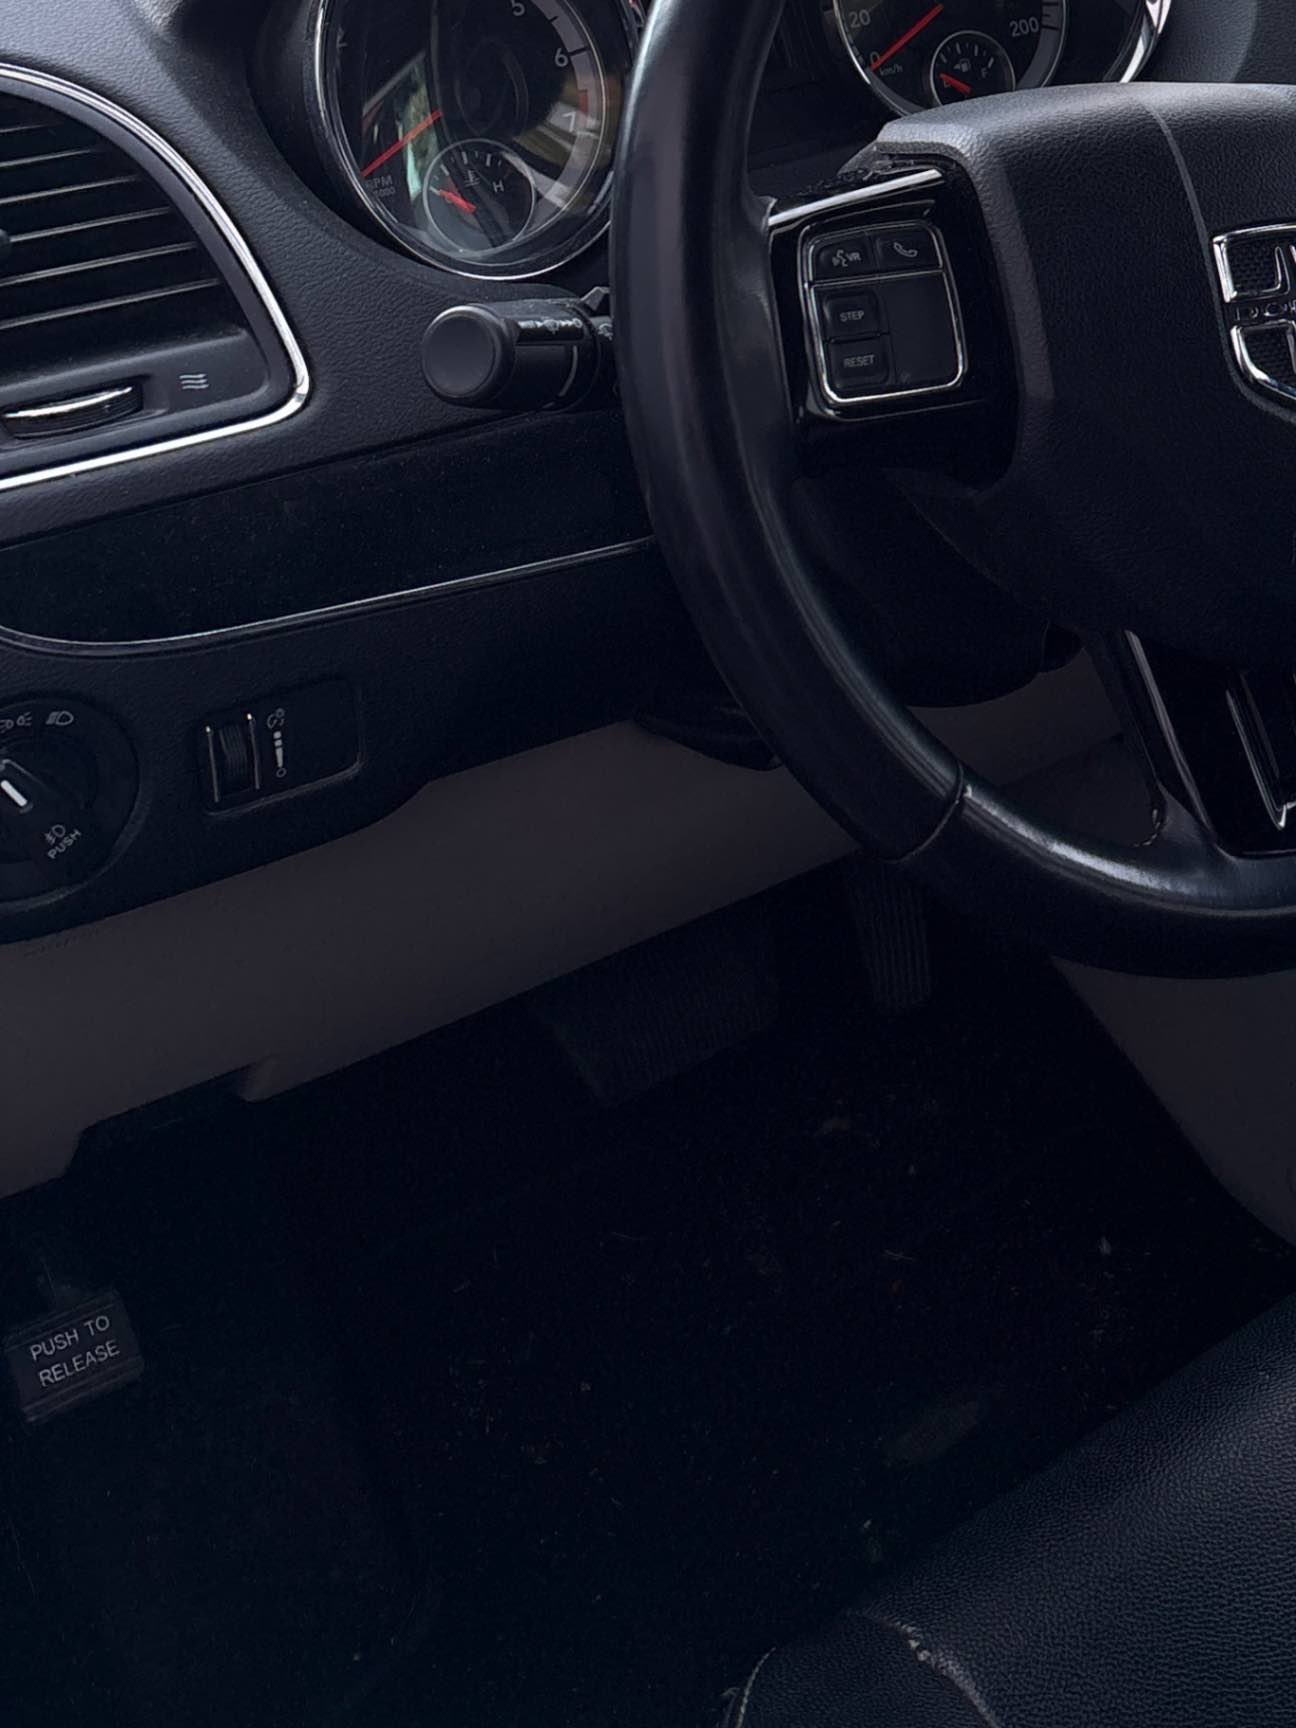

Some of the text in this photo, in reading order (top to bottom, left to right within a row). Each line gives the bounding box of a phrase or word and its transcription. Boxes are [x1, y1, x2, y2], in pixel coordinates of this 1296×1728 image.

[849, 9, 871, 29] 20
[1009, 16, 1040, 38] 200
[553, 47, 569, 68] 6
[561, 111, 577, 133] 7
[839, 309, 865, 322] STEP
[843, 354, 876, 368] RESET
[47, 828, 82, 860] PUSH
[29, 1315, 110, 1361] PUSH TO
[38, 1339, 121, 1387] RELEASE
